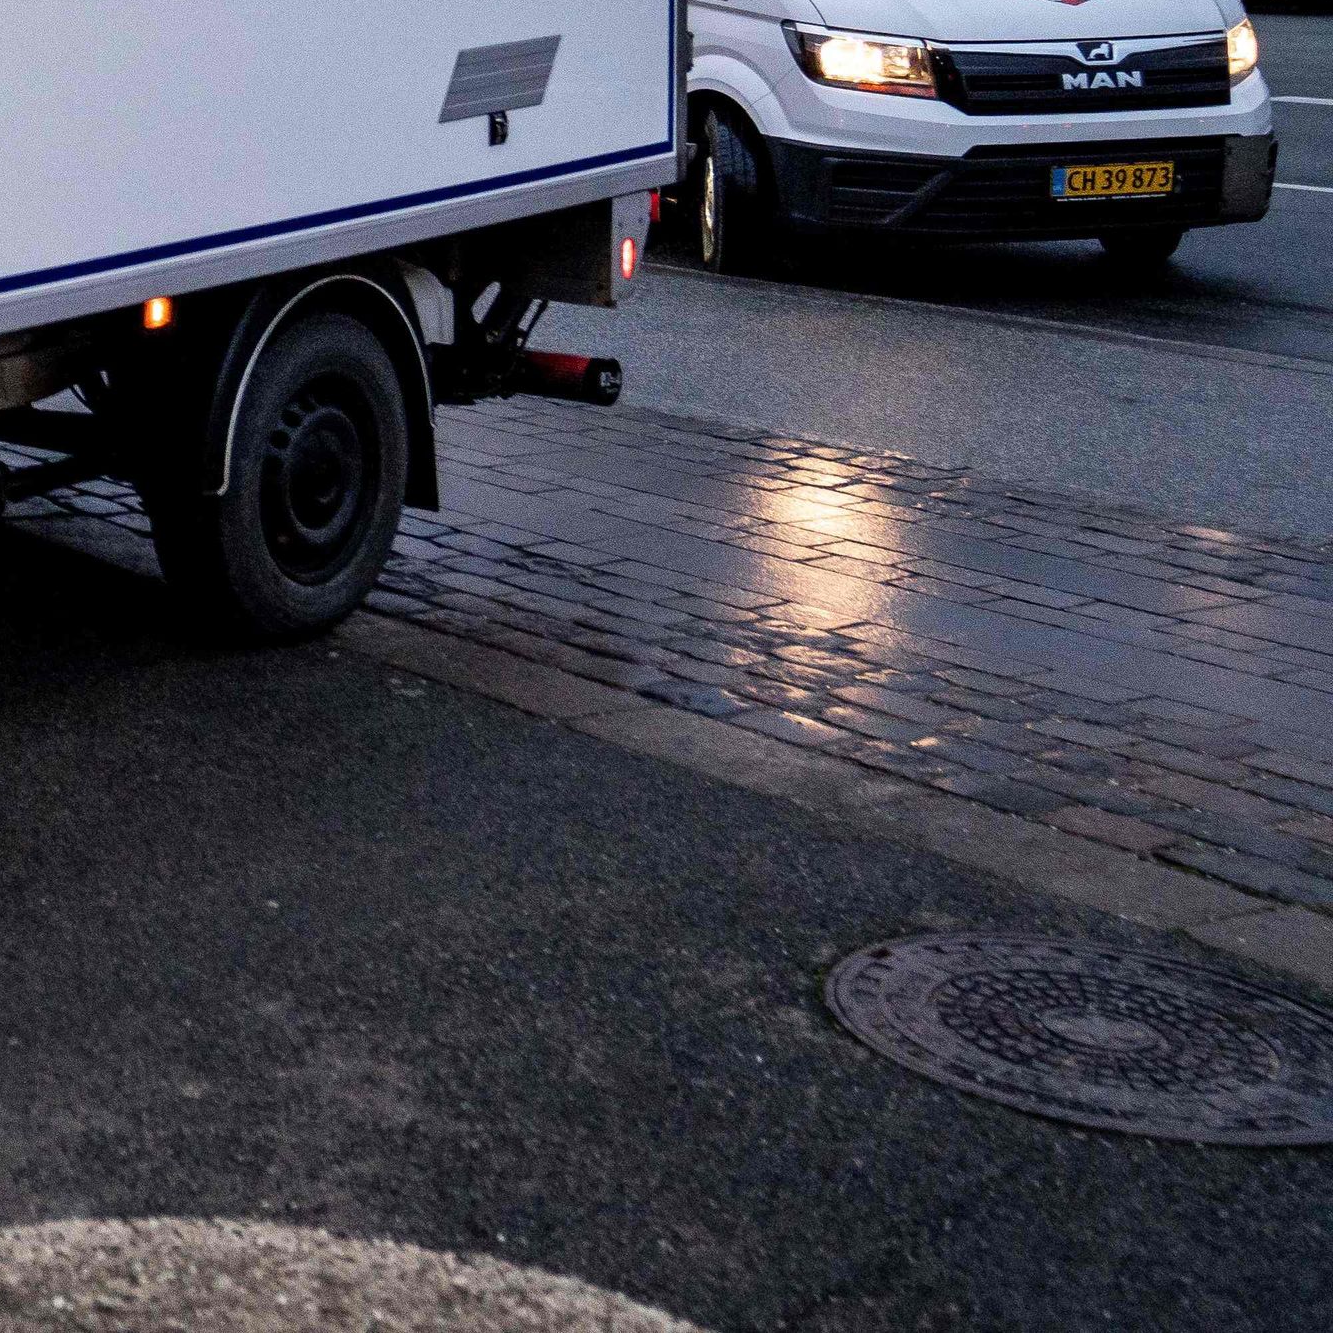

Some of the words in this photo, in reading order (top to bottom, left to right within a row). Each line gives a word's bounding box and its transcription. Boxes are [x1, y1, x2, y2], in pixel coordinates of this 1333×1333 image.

[1061, 70, 1144, 90] MAN
[1068, 170, 1096, 191] CH
[1101, 168, 1127, 190] 39
[1132, 166, 1170, 188] 873
